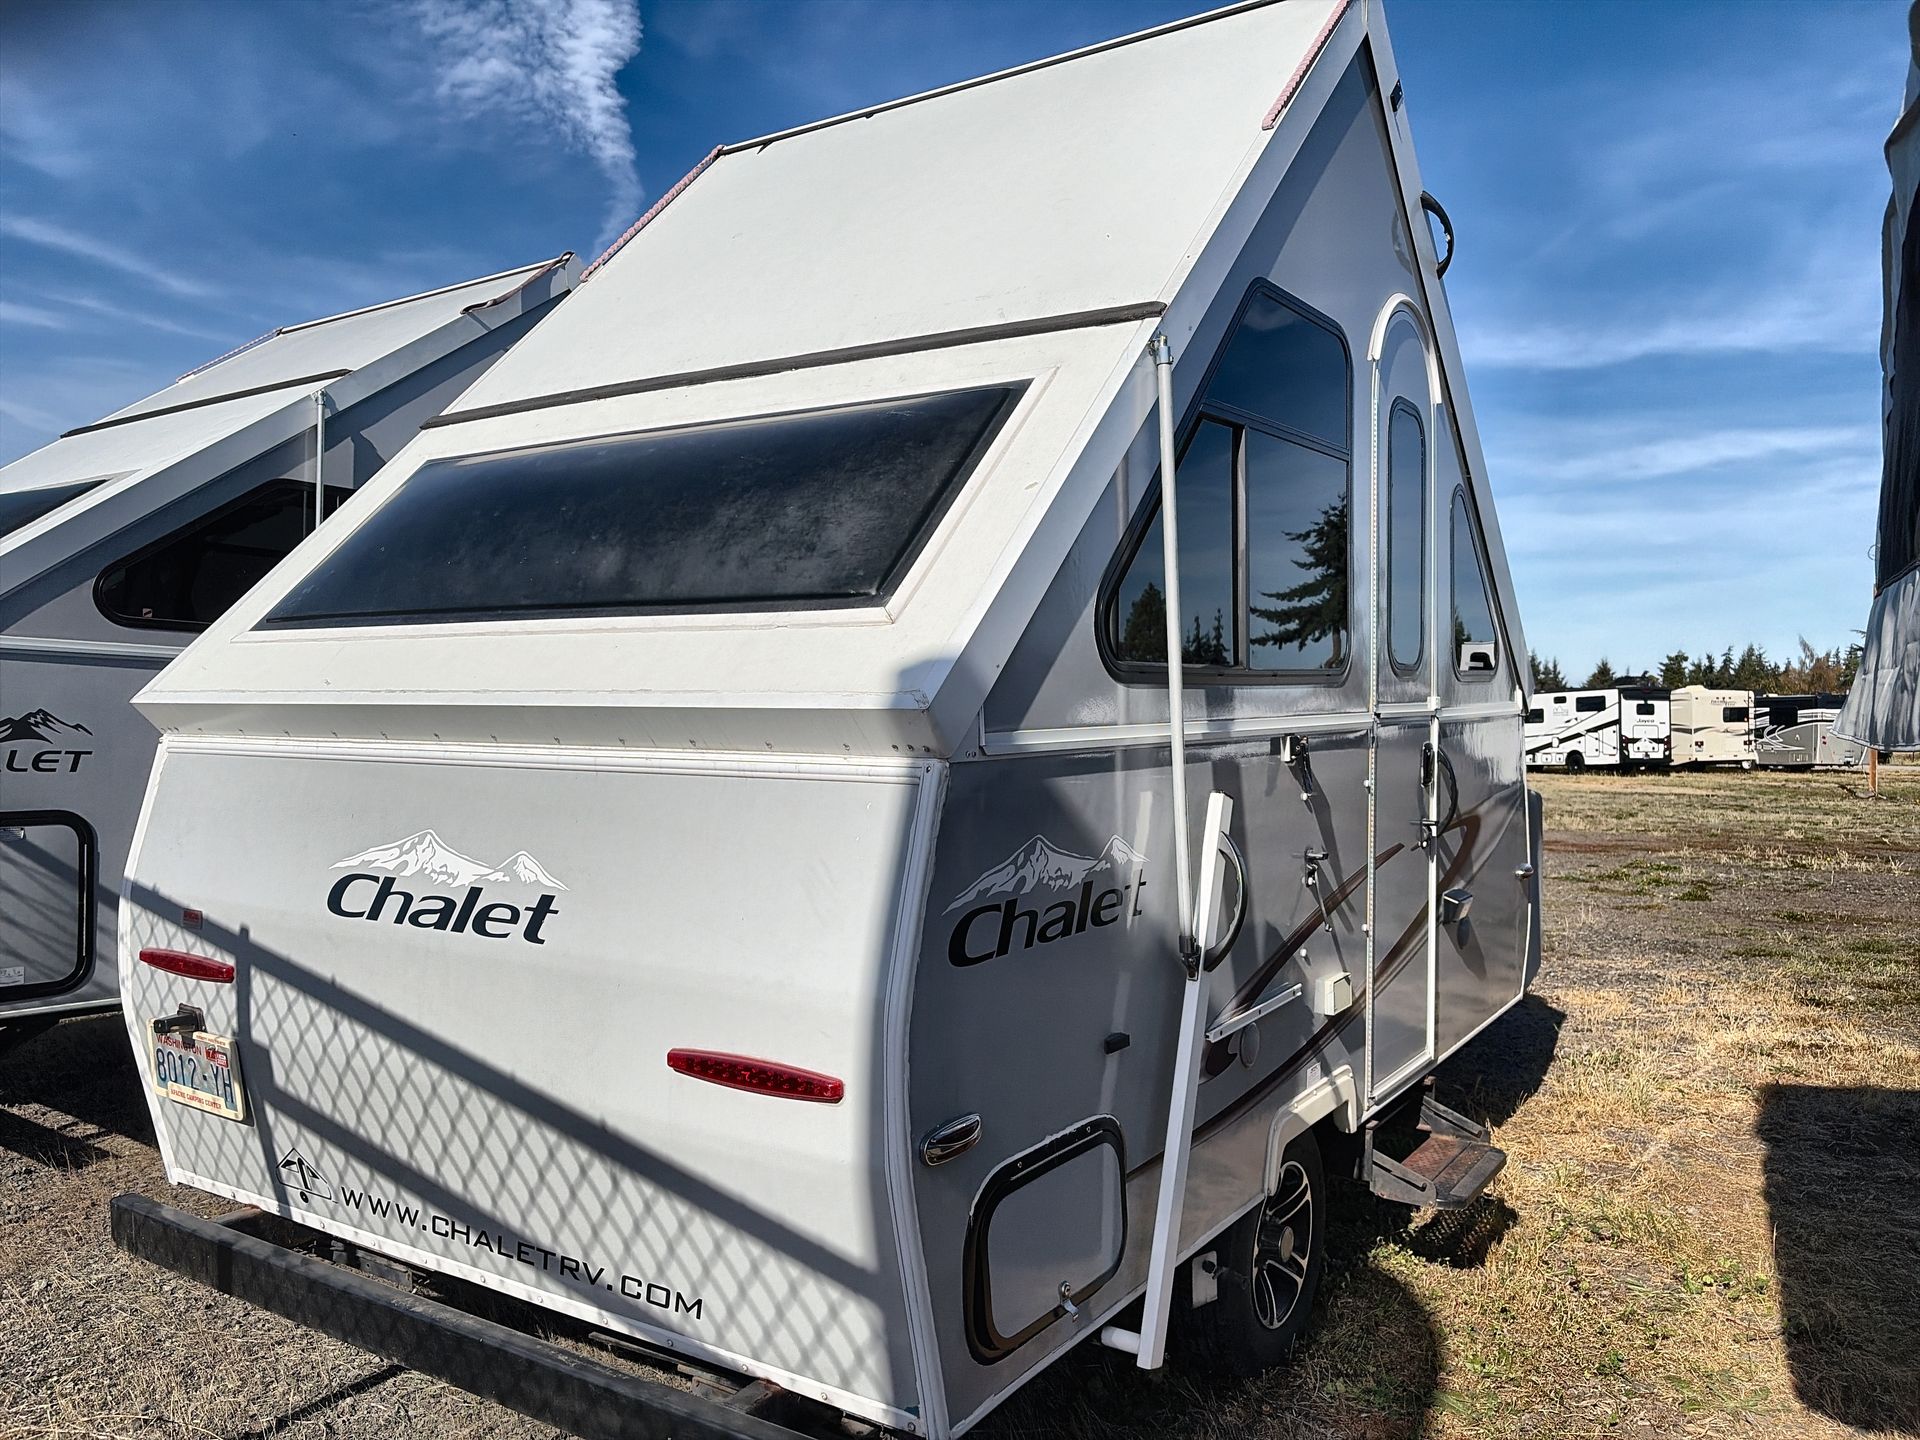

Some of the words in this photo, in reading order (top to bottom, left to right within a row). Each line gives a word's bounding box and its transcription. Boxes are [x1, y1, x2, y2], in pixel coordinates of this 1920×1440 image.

[0, 749, 94, 773] LET
[326, 873, 560, 945] Chalet
[947, 868, 1147, 968] Chalet
[340, 1185, 704, 1320] WWW.CHALETRV.COM
